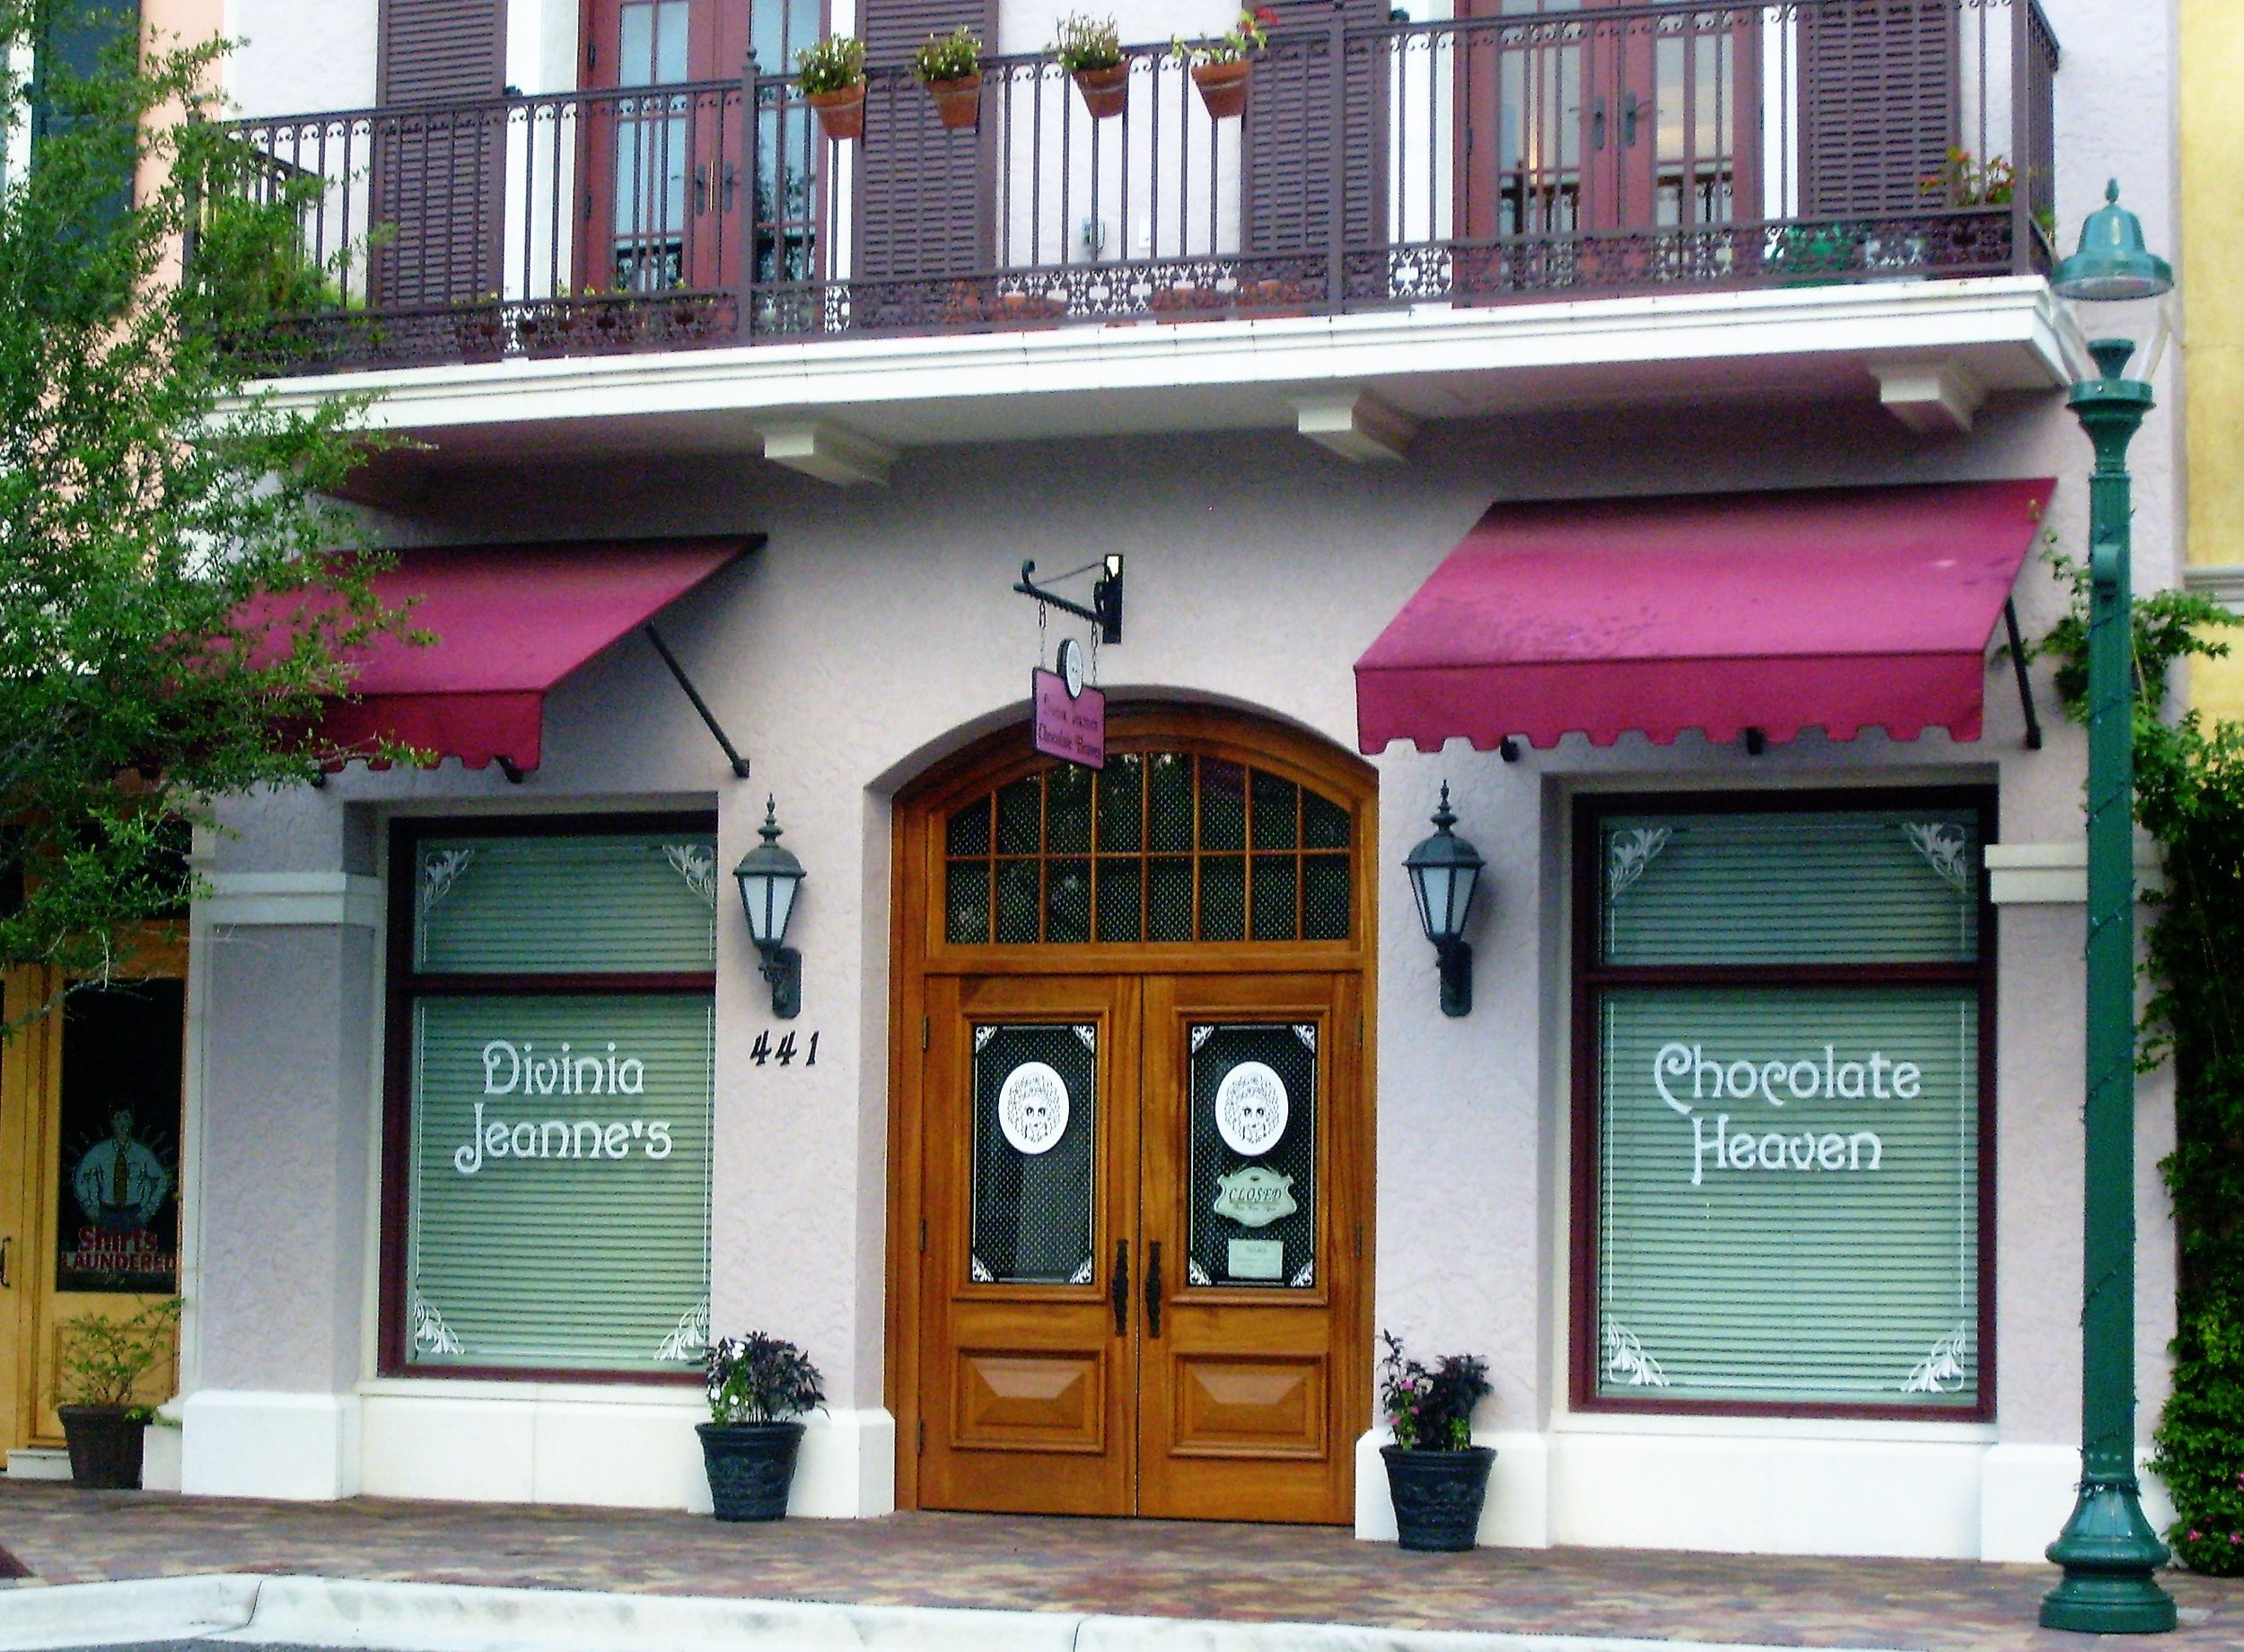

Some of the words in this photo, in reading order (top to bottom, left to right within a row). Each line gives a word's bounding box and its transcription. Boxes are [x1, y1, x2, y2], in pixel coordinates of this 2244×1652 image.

[483, 1040, 644, 1095] Divinia
[749, 1029, 820, 1067] 441
[1654, 1042, 1922, 1115] Chocolate
[454, 1103, 673, 1174] Jeanne's
[1691, 1114, 1883, 1186] Heaven
[1229, 1187, 1283, 1203] CLOSED
[78, 1224, 160, 1253] Shirts
